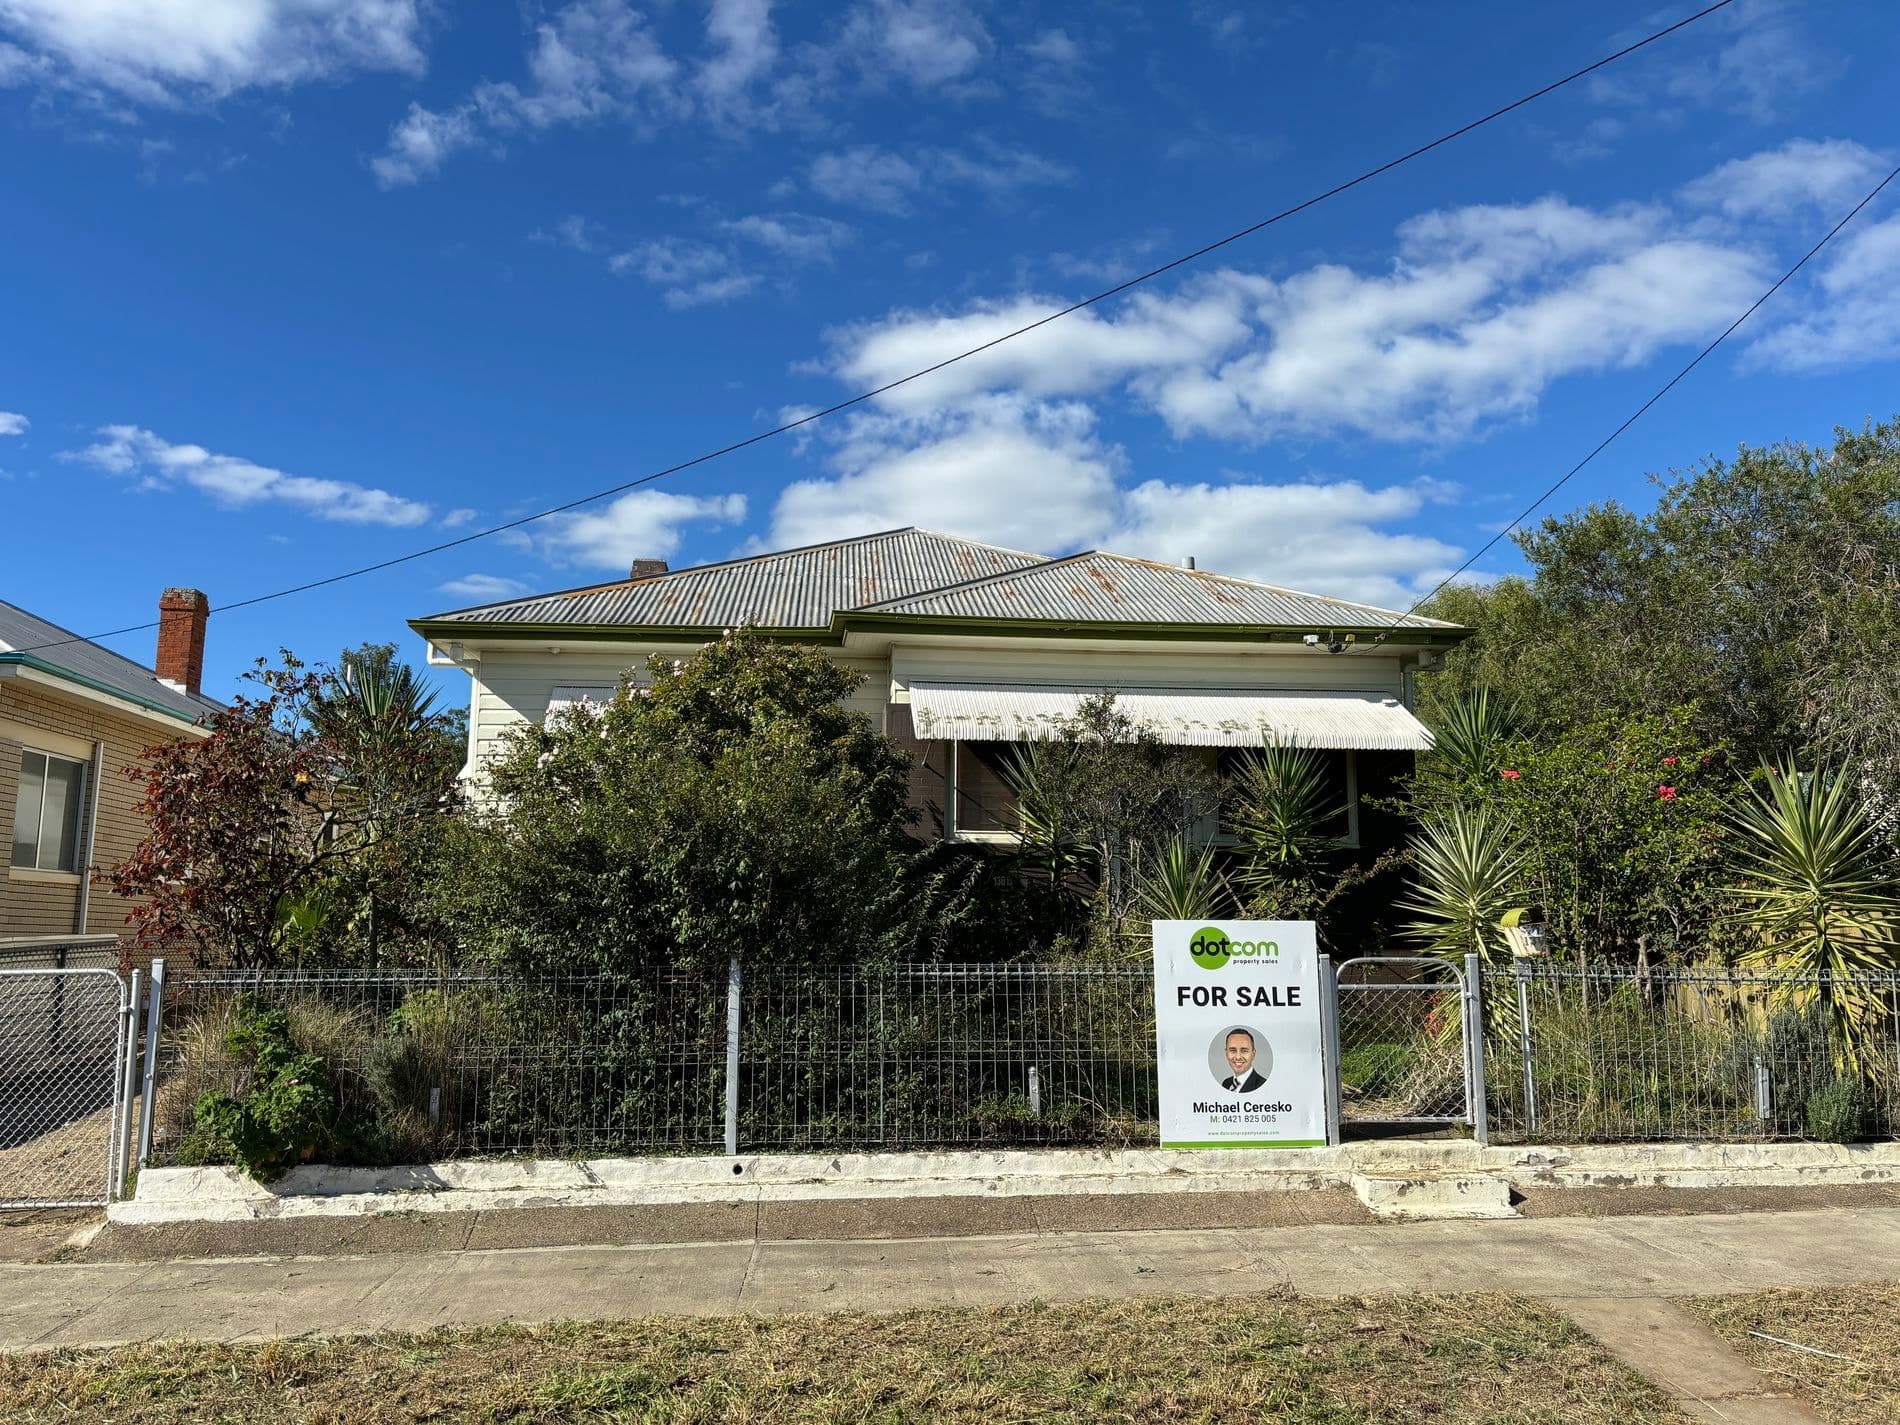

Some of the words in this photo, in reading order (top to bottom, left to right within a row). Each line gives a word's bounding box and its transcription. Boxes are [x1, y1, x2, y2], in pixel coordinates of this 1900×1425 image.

[1190, 936, 1279, 956] dotcom
[1177, 986, 1228, 1007] FOR
[1236, 986, 1301, 1007] SALE
[1193, 1102, 1240, 1113] Michael
[1243, 1101, 1292, 1112] Ceresko
[1222, 1115, 1242, 1123] 0421
